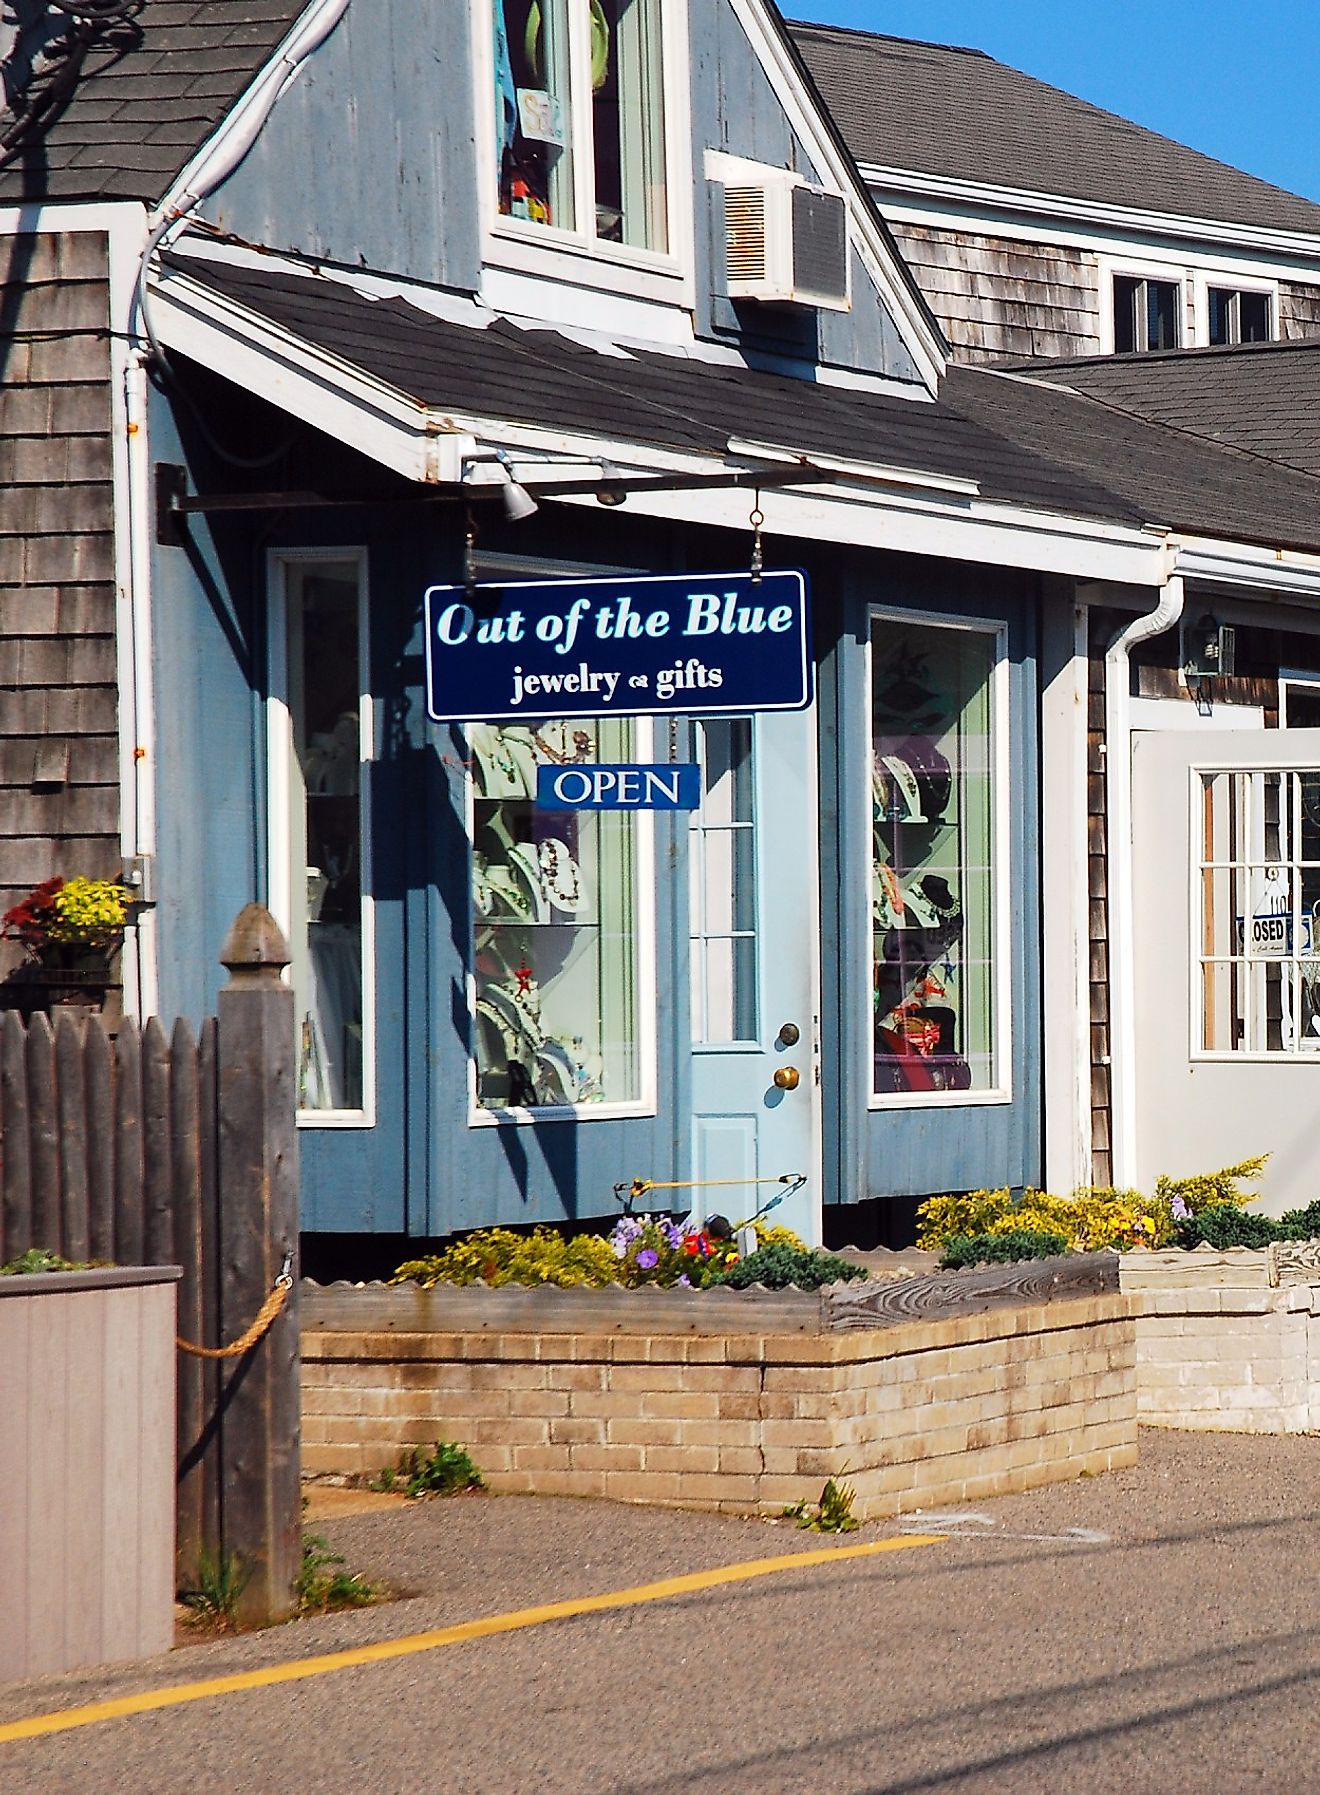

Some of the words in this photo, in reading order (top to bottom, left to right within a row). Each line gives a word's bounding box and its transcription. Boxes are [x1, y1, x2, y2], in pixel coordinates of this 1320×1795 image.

[437, 602, 525, 645] Out
[536, 597, 591, 655] of
[596, 597, 671, 639] the
[683, 592, 793, 636] Blue
[510, 662, 621, 705] jewelry
[656, 658, 723, 698] gifts
[554, 770, 679, 804] OPEN
[1238, 919, 1284, 943] COSED
